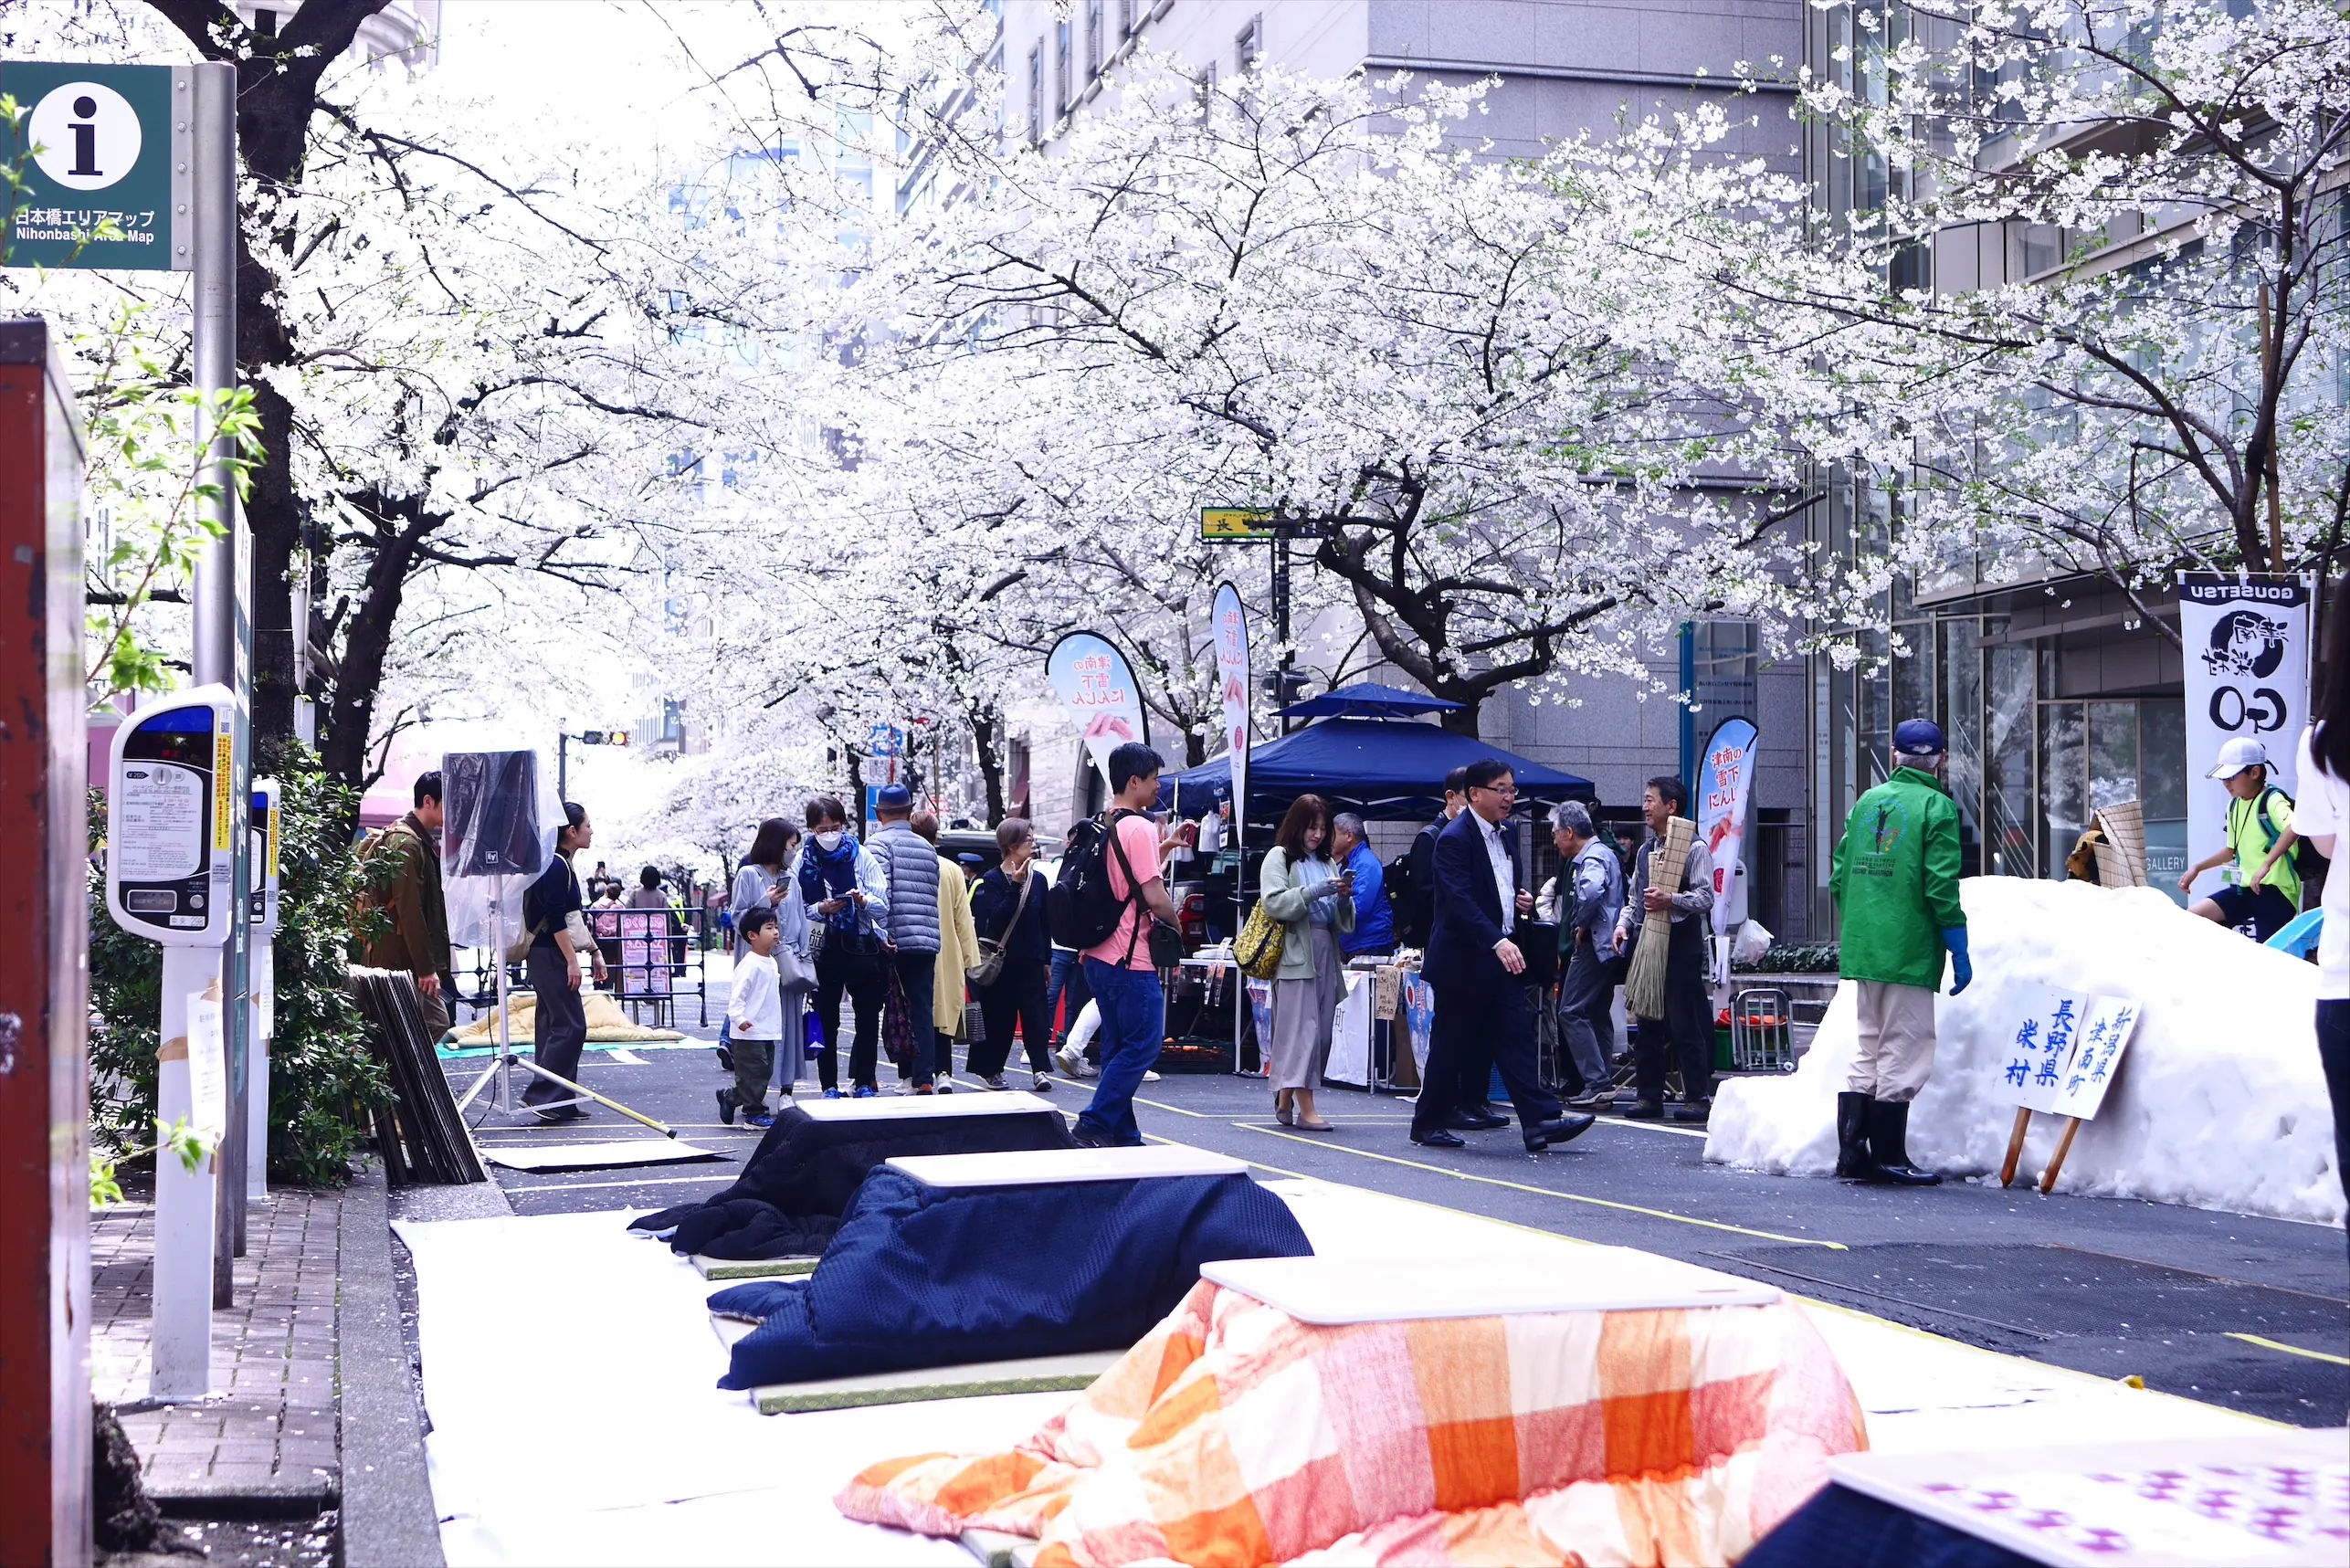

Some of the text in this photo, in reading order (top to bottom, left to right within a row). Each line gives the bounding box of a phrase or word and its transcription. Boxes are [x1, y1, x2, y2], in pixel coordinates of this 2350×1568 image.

[16, 207, 154, 227] 日本橋エリアマップ
[128, 230, 154, 245] Map
[1712, 747, 1742, 768] 津南の
[1716, 765, 1739, 787] 雪下
[2145, 857, 2186, 871] GALLERY
[2004, 1018, 2039, 1088] 栄村
[2033, 999, 2075, 1088] 長野県
[2091, 1005, 2133, 1083] 新潟県
[2066, 1017, 2107, 1098] 津南町
